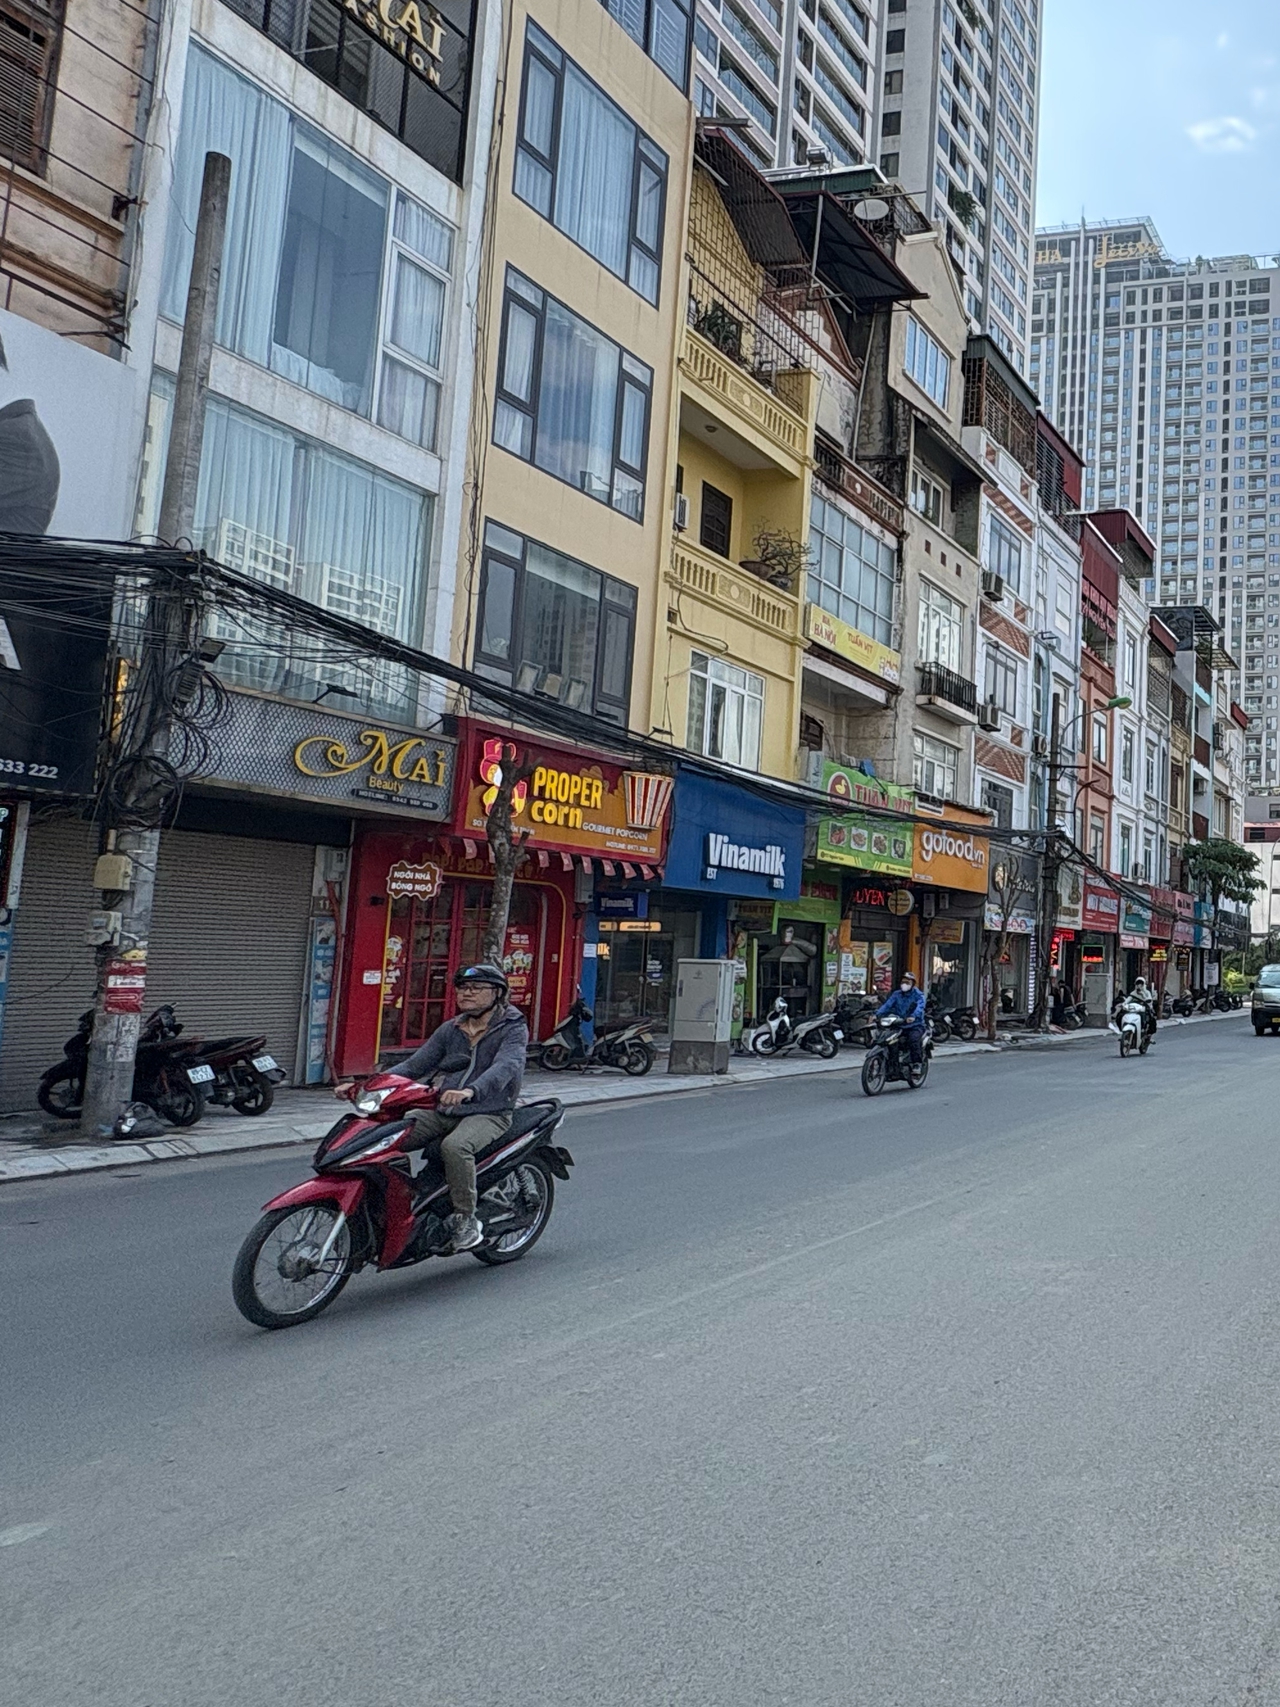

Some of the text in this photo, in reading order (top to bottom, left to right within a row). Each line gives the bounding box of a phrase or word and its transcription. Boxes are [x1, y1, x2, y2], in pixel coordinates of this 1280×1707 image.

[28, 762, 59, 779] 222
[368, 776, 404, 794] Beauty
[533, 766, 603, 810] PROPER
[531, 800, 584, 829] corn
[582, 821, 649, 842] GOURMET POPCORN
[709, 832, 786, 877] Vinamilk
[706, 867, 718, 880] EST
